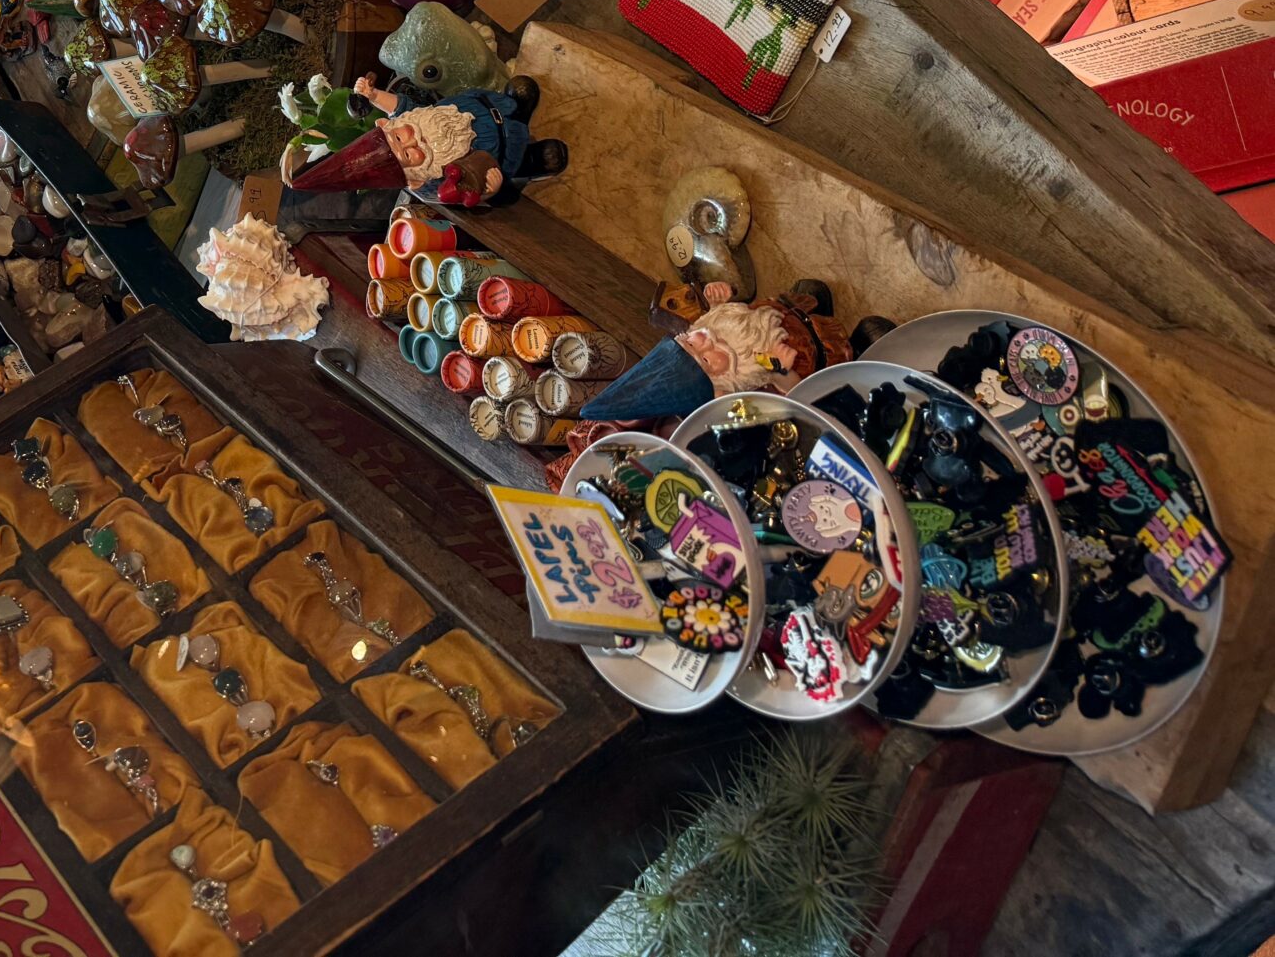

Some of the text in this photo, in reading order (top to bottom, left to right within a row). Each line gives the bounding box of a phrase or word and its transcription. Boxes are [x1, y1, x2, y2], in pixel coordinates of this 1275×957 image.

[1113, 27, 1148, 42] colour
[1149, 19, 1181, 32] cards
[113, 70, 148, 114] CERAMIC
[1109, 99, 1195, 126] NOLOGY
[786, 484, 812, 512] PARTY
[820, 450, 872, 504] TRYING
[1097, 441, 1161, 510] COORDINATOR
[677, 533, 694, 556] SILLY
[1136, 489, 1191, 555] HERE
[1154, 513, 1204, 570] WORK
[523, 512, 579, 604] LAPEL
[1170, 535, 1216, 588] JUST
